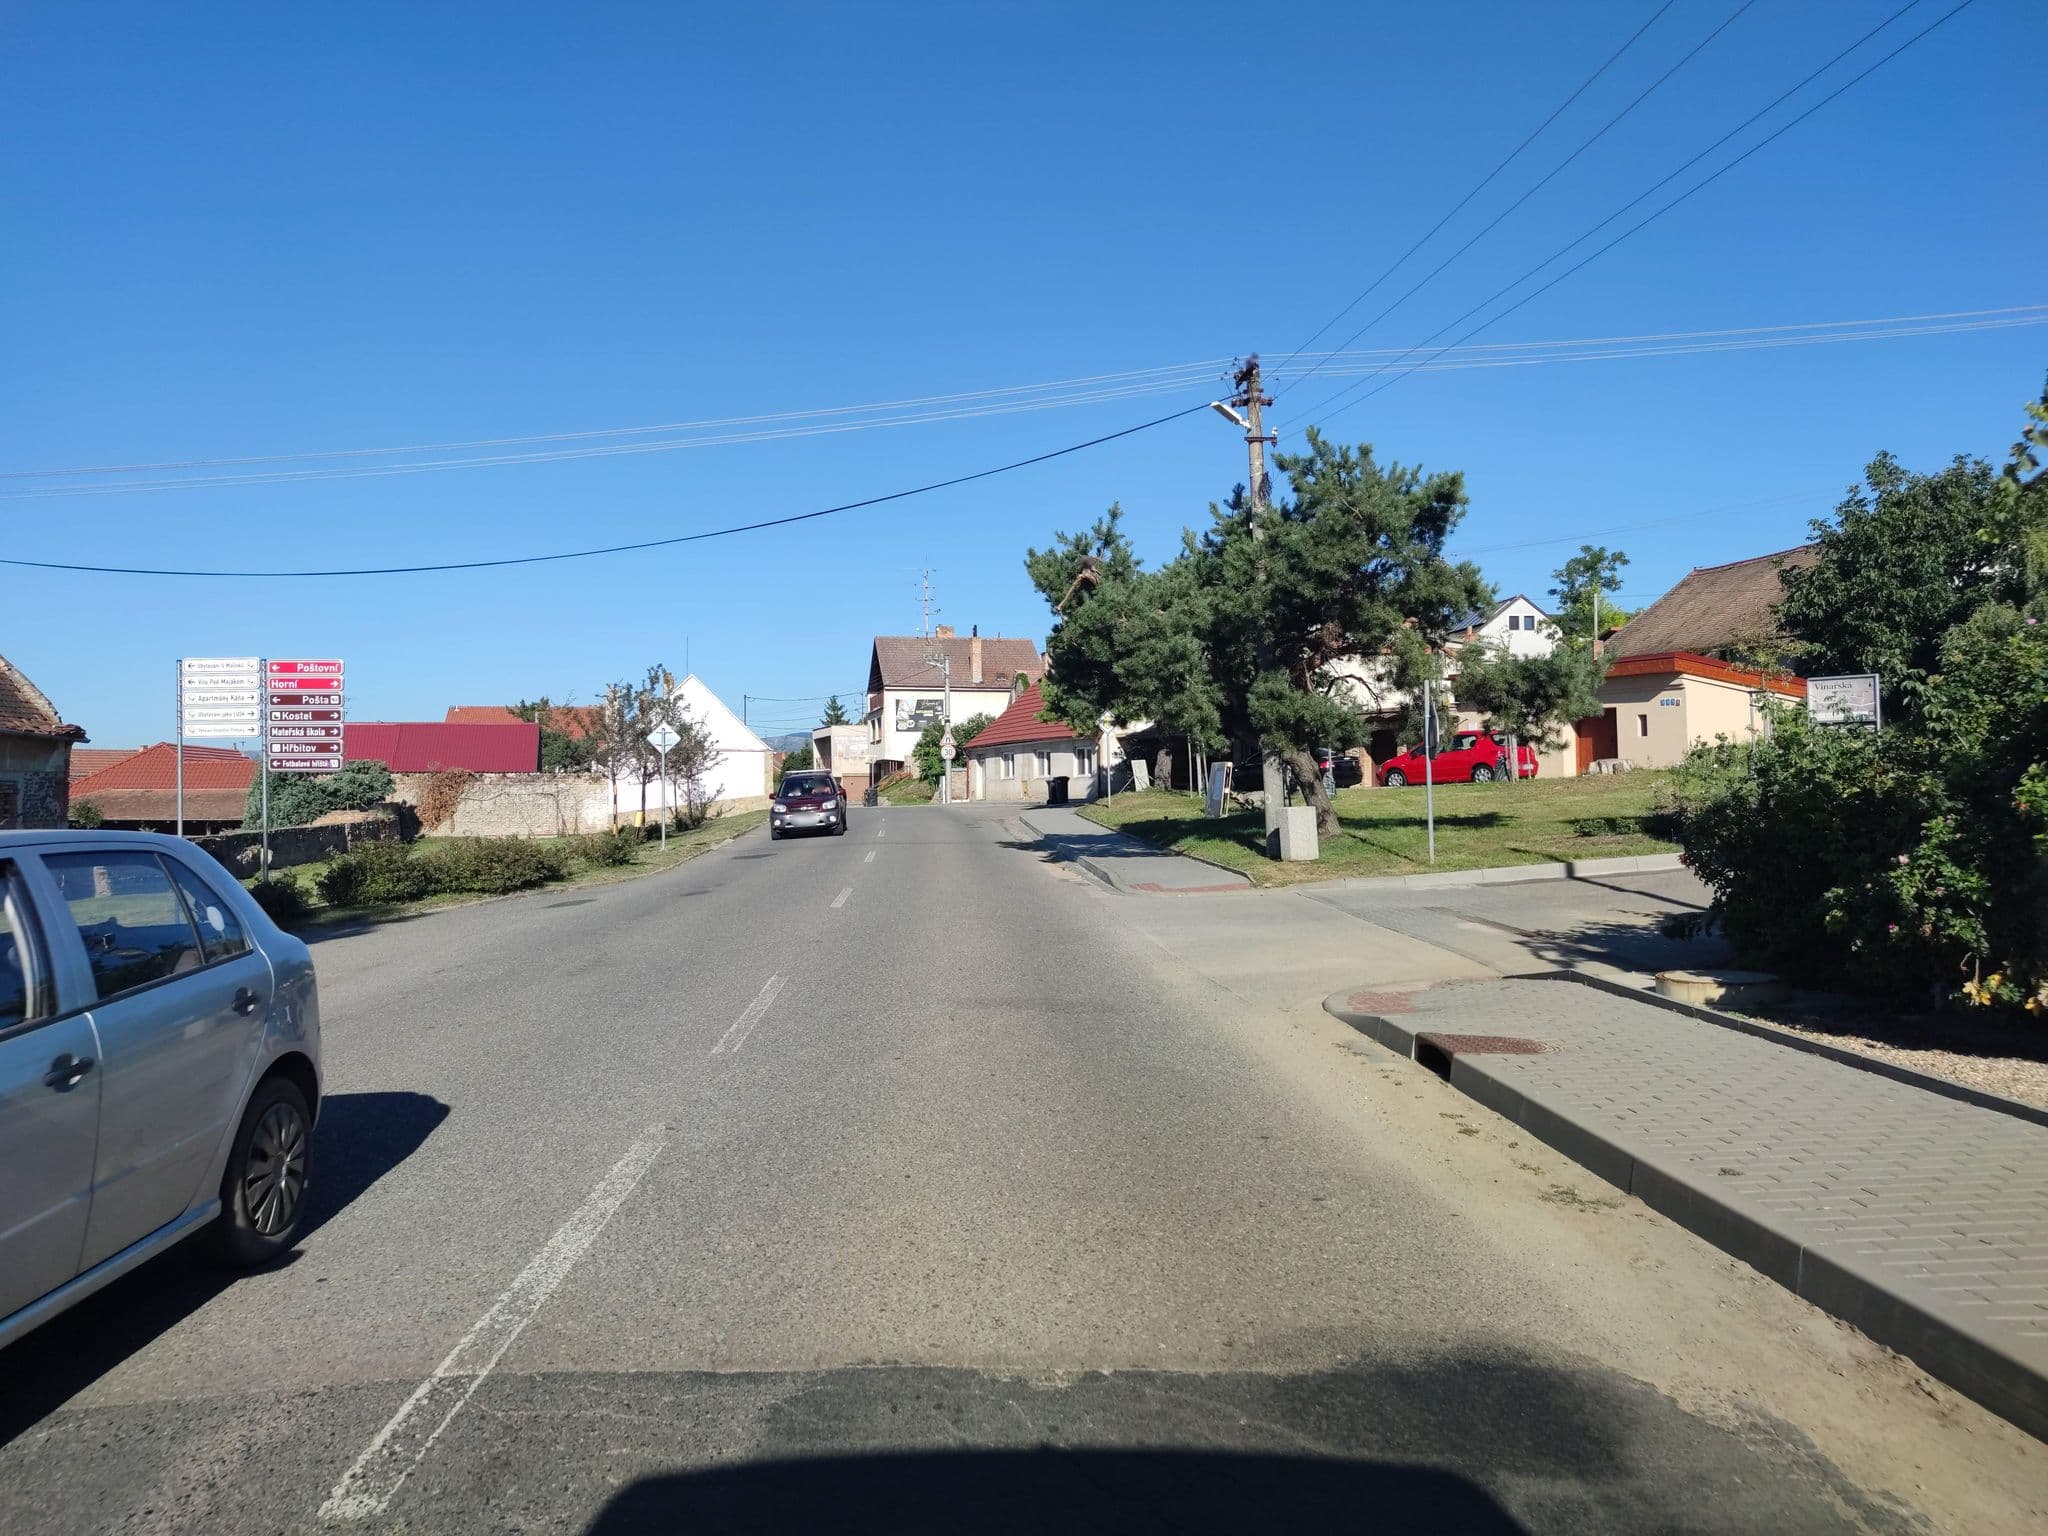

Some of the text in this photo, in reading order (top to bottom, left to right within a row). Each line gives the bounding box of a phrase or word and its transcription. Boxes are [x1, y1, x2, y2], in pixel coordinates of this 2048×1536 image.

[297, 663, 338, 673] Poštovní
[271, 679, 298, 688] Horní
[302, 695, 329, 704] Pošta
[282, 711, 312, 720] Kostel
[271, 727, 325, 736] Mateřská škola
[282, 743, 316, 752] Hřbitov
[282, 759, 329, 768] Fotbalové hřiště
